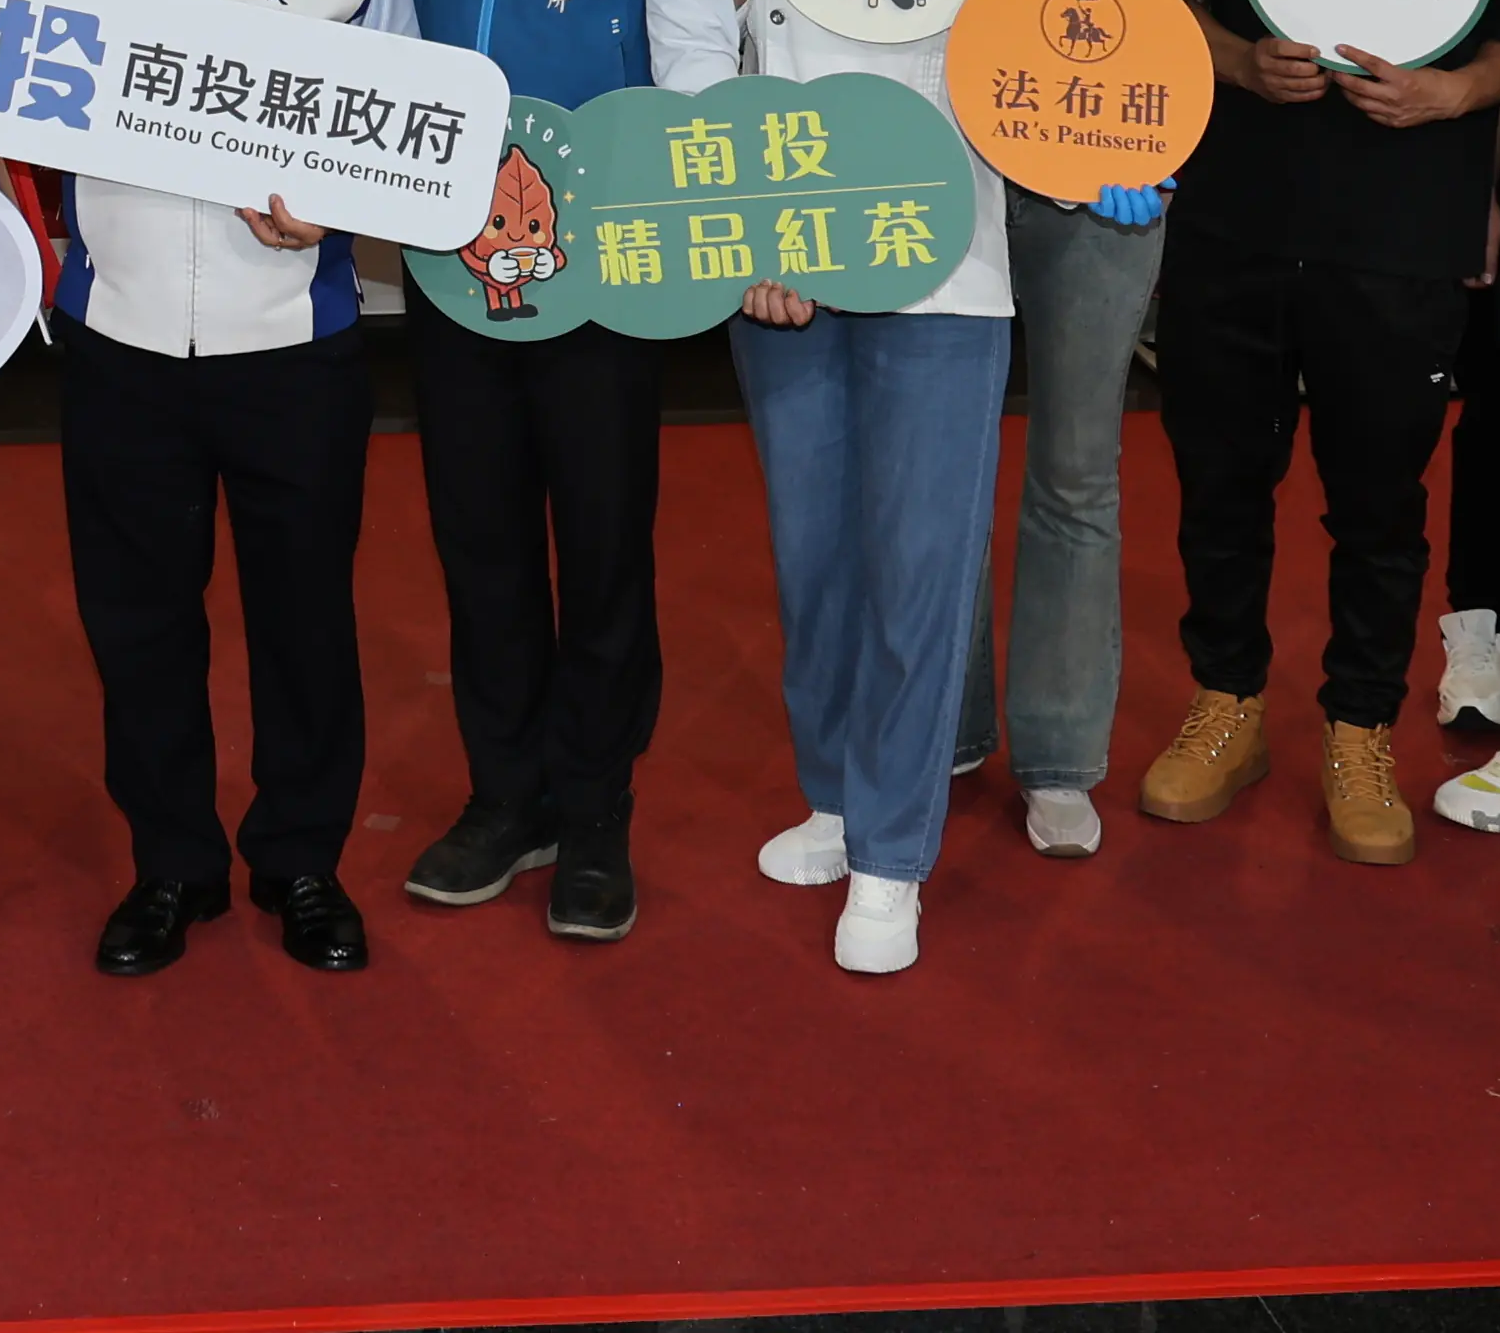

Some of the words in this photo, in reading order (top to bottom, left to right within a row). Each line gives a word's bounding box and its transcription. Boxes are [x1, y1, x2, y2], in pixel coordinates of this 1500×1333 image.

[121, 40, 466, 165] 南投縣政府
[991, 68, 1171, 128] 法布甜
[991, 119, 1051, 143] AR's
[1055, 122, 1168, 156] Patisserie
[115, 108, 202, 147] Nantou
[209, 129, 297, 169] County
[302, 149, 453, 199] Government
[664, 110, 837, 190] 南投
[594, 198, 938, 287] 精品紅茶
